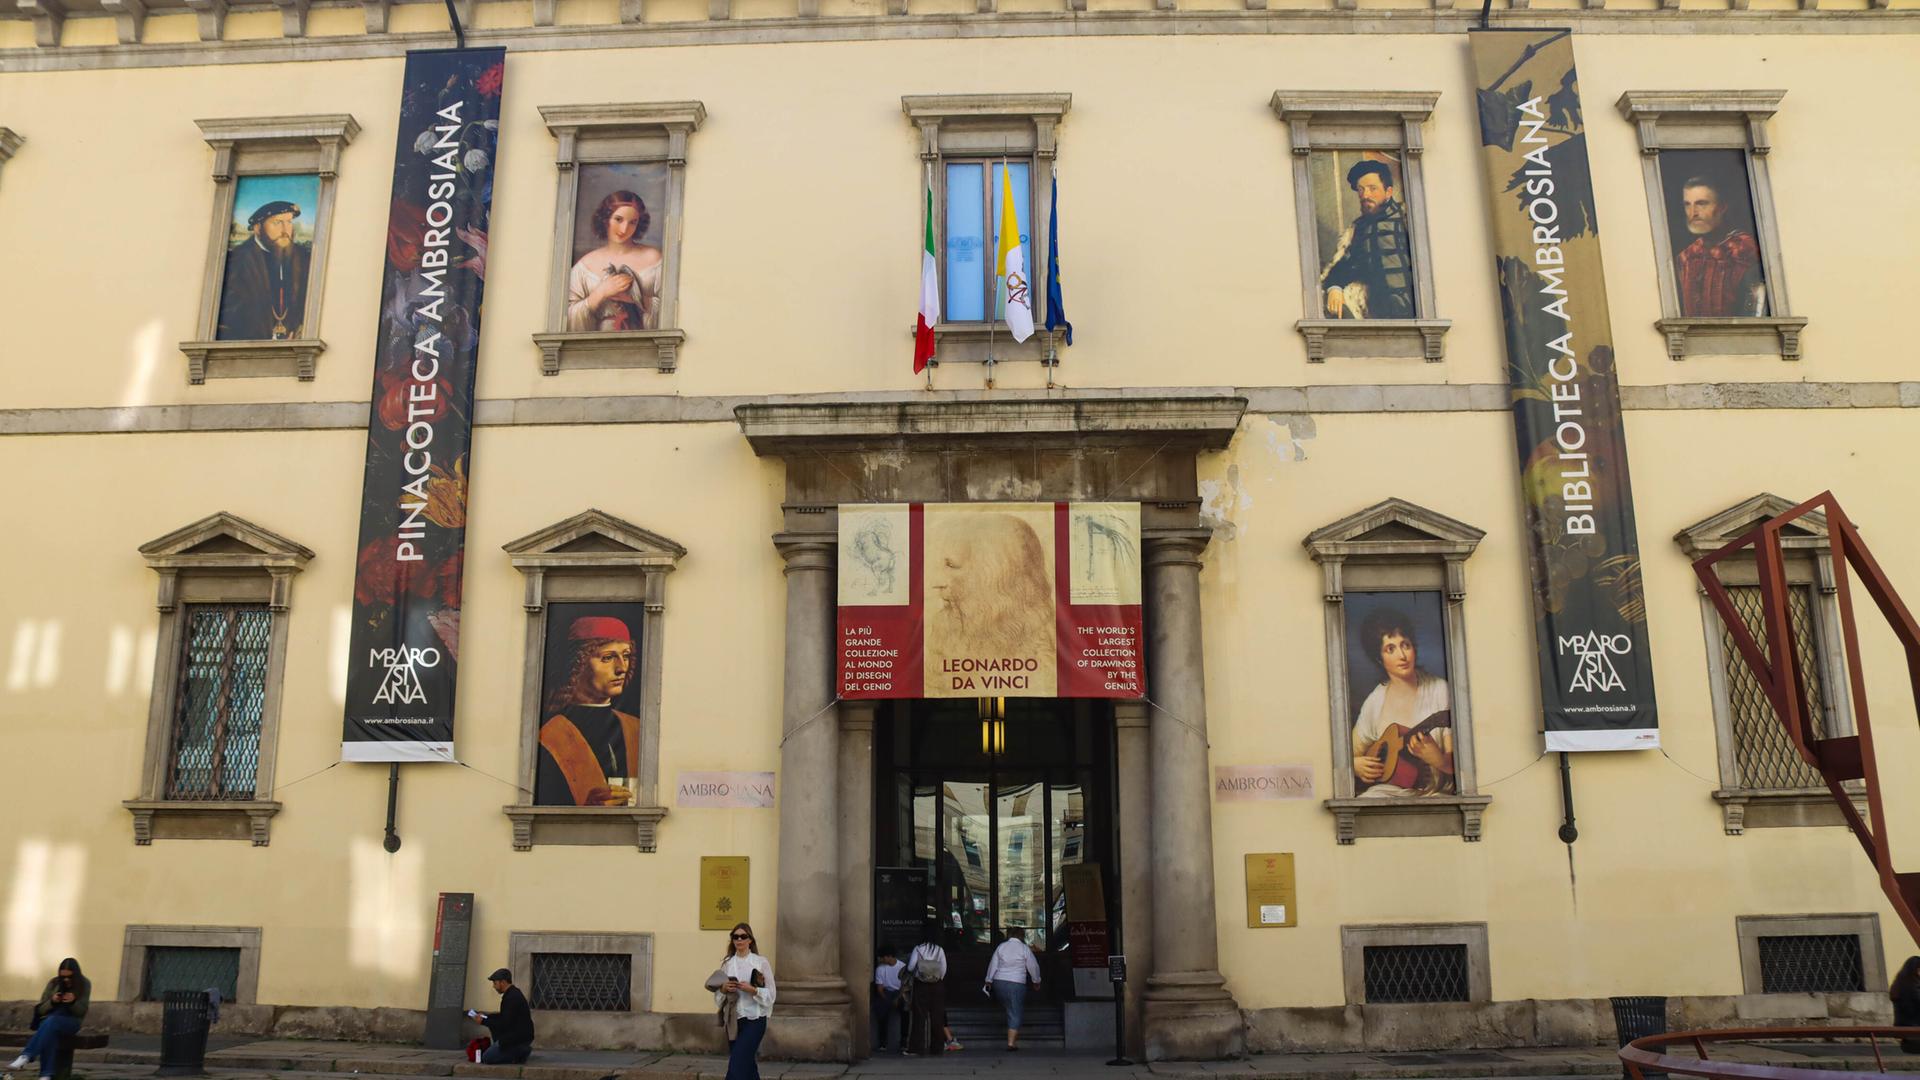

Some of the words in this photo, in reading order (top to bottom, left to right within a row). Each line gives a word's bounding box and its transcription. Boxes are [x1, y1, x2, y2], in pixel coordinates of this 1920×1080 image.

[1516, 95, 1569, 318] AMBROSIANA
[396, 333, 442, 561] PINACOTECA
[421, 100, 464, 322] AMBROSIANA
[1551, 333, 1597, 536] BIBLIOTECA
[858, 626, 872, 635] PIÙ
[1097, 627, 1135, 635] WORLD'S
[1098, 638, 1135, 646] LARGEST
[1082, 648, 1136, 657] COLLECTION
[943, 658, 1038, 672] LEONARDO
[1077, 660, 1088, 668] OF
[1091, 660, 1136, 668] DRAWINGS
[845, 672, 854, 680] DI
[856, 672, 892, 680] DISEGNI
[1107, 671, 1117, 679] BY
[1120, 671, 1136, 679] THE
[952, 677, 976, 689] DA
[981, 675, 1029, 689] VINCI
[1104, 682, 1137, 690] GENIUS
[845, 683, 861, 691] DEL
[862, 683, 892, 691] GENIO
[1563, 704, 1637, 713] www.ambrosiana.it
[364, 716, 434, 725] www.ambrosiana.it
[1217, 776, 1313, 791] AMBROSIANA
